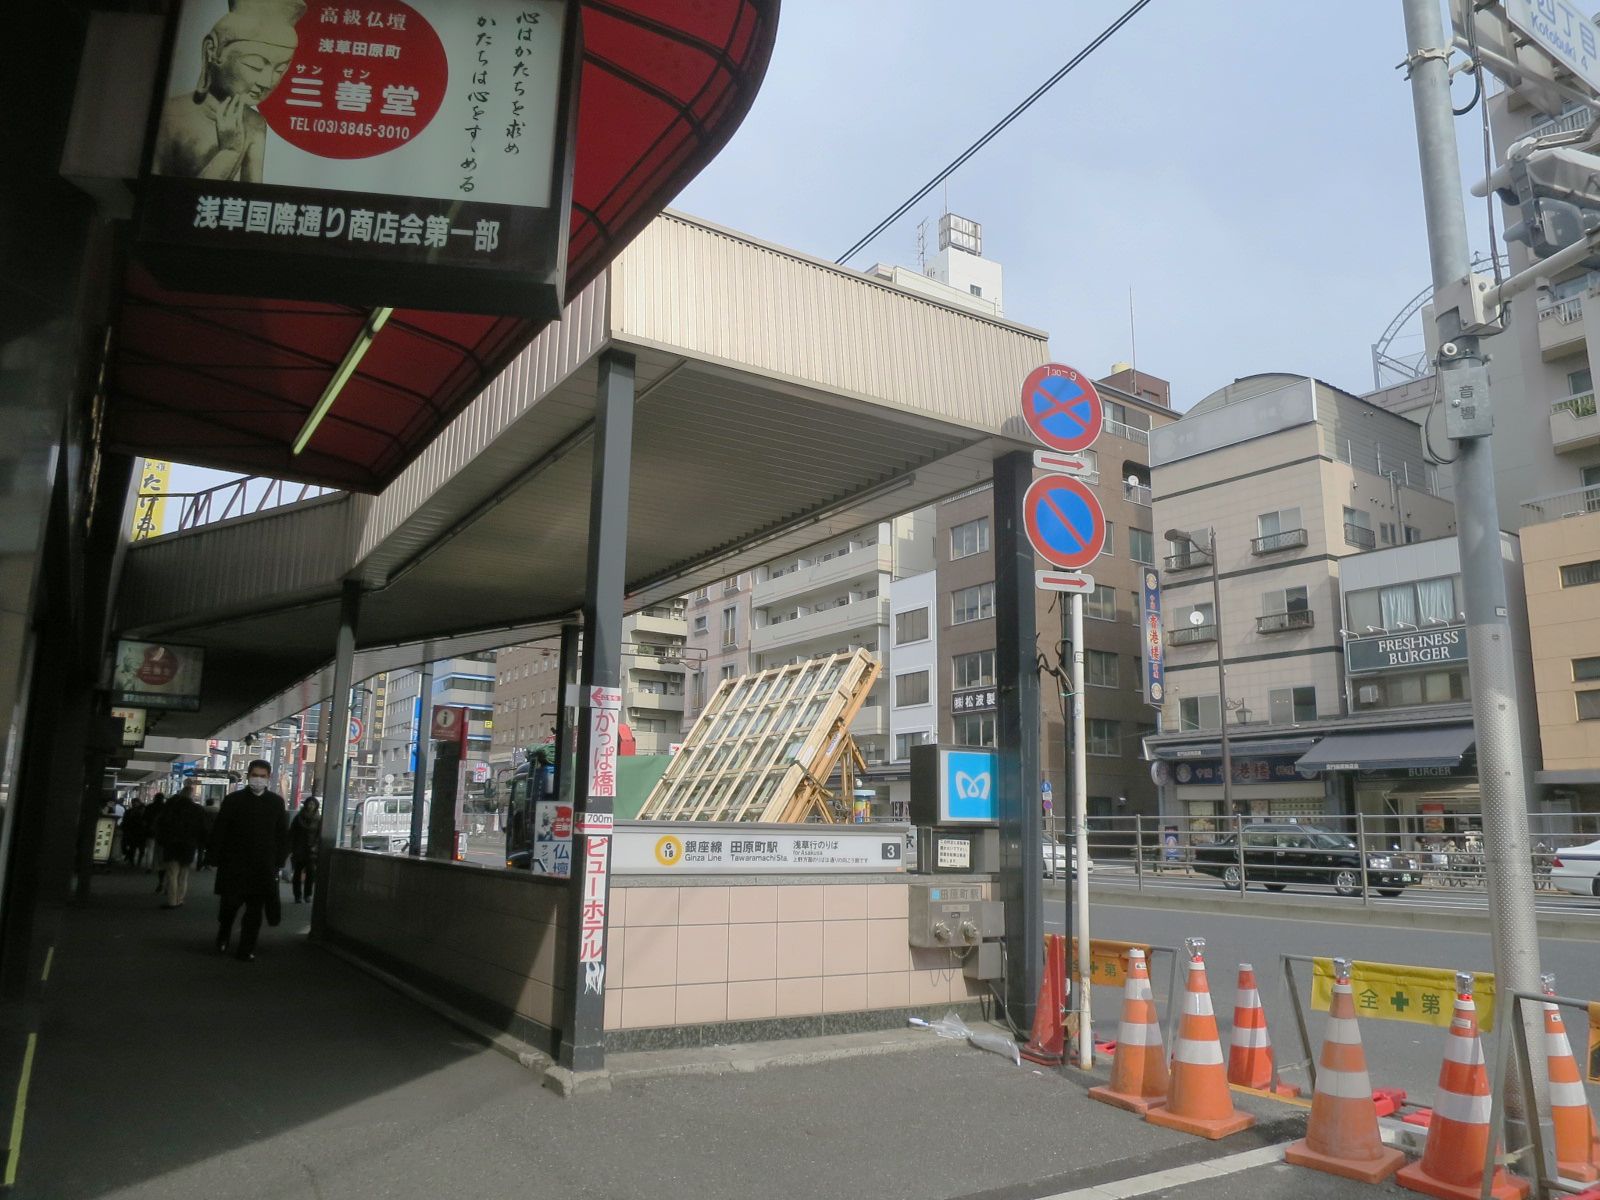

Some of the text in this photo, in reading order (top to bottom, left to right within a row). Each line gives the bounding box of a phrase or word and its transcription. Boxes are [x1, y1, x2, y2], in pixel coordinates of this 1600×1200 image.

[320, 7, 406, 31] 高級仏壇
[318, 38, 401, 60] 浅草田原町
[285, 77, 420, 117] 三善堂
[290, 116, 411, 140] TEL (03)3845-3010
[193, 195, 501, 253] 浅草国際通り商店会第一部
[1378, 631, 1460, 653] FRESHNESS
[1389, 646, 1451, 665] BURGER
[592, 709, 616, 796] かっぱ橋
[1408, 766, 1452, 777] BURGER
[587, 814, 612, 823] 700m
[664, 850, 674, 858] 18
[685, 841, 778, 854] 銀座線 田原町駅
[793, 840, 839, 850] 浅草行のりば
[886, 844, 896, 858] 3
[685, 854, 705, 862] Ginza
[708, 854, 722, 862] Line
[731, 854, 776, 862] Tawaramachi
[580, 837, 609, 961] ビューホテル
